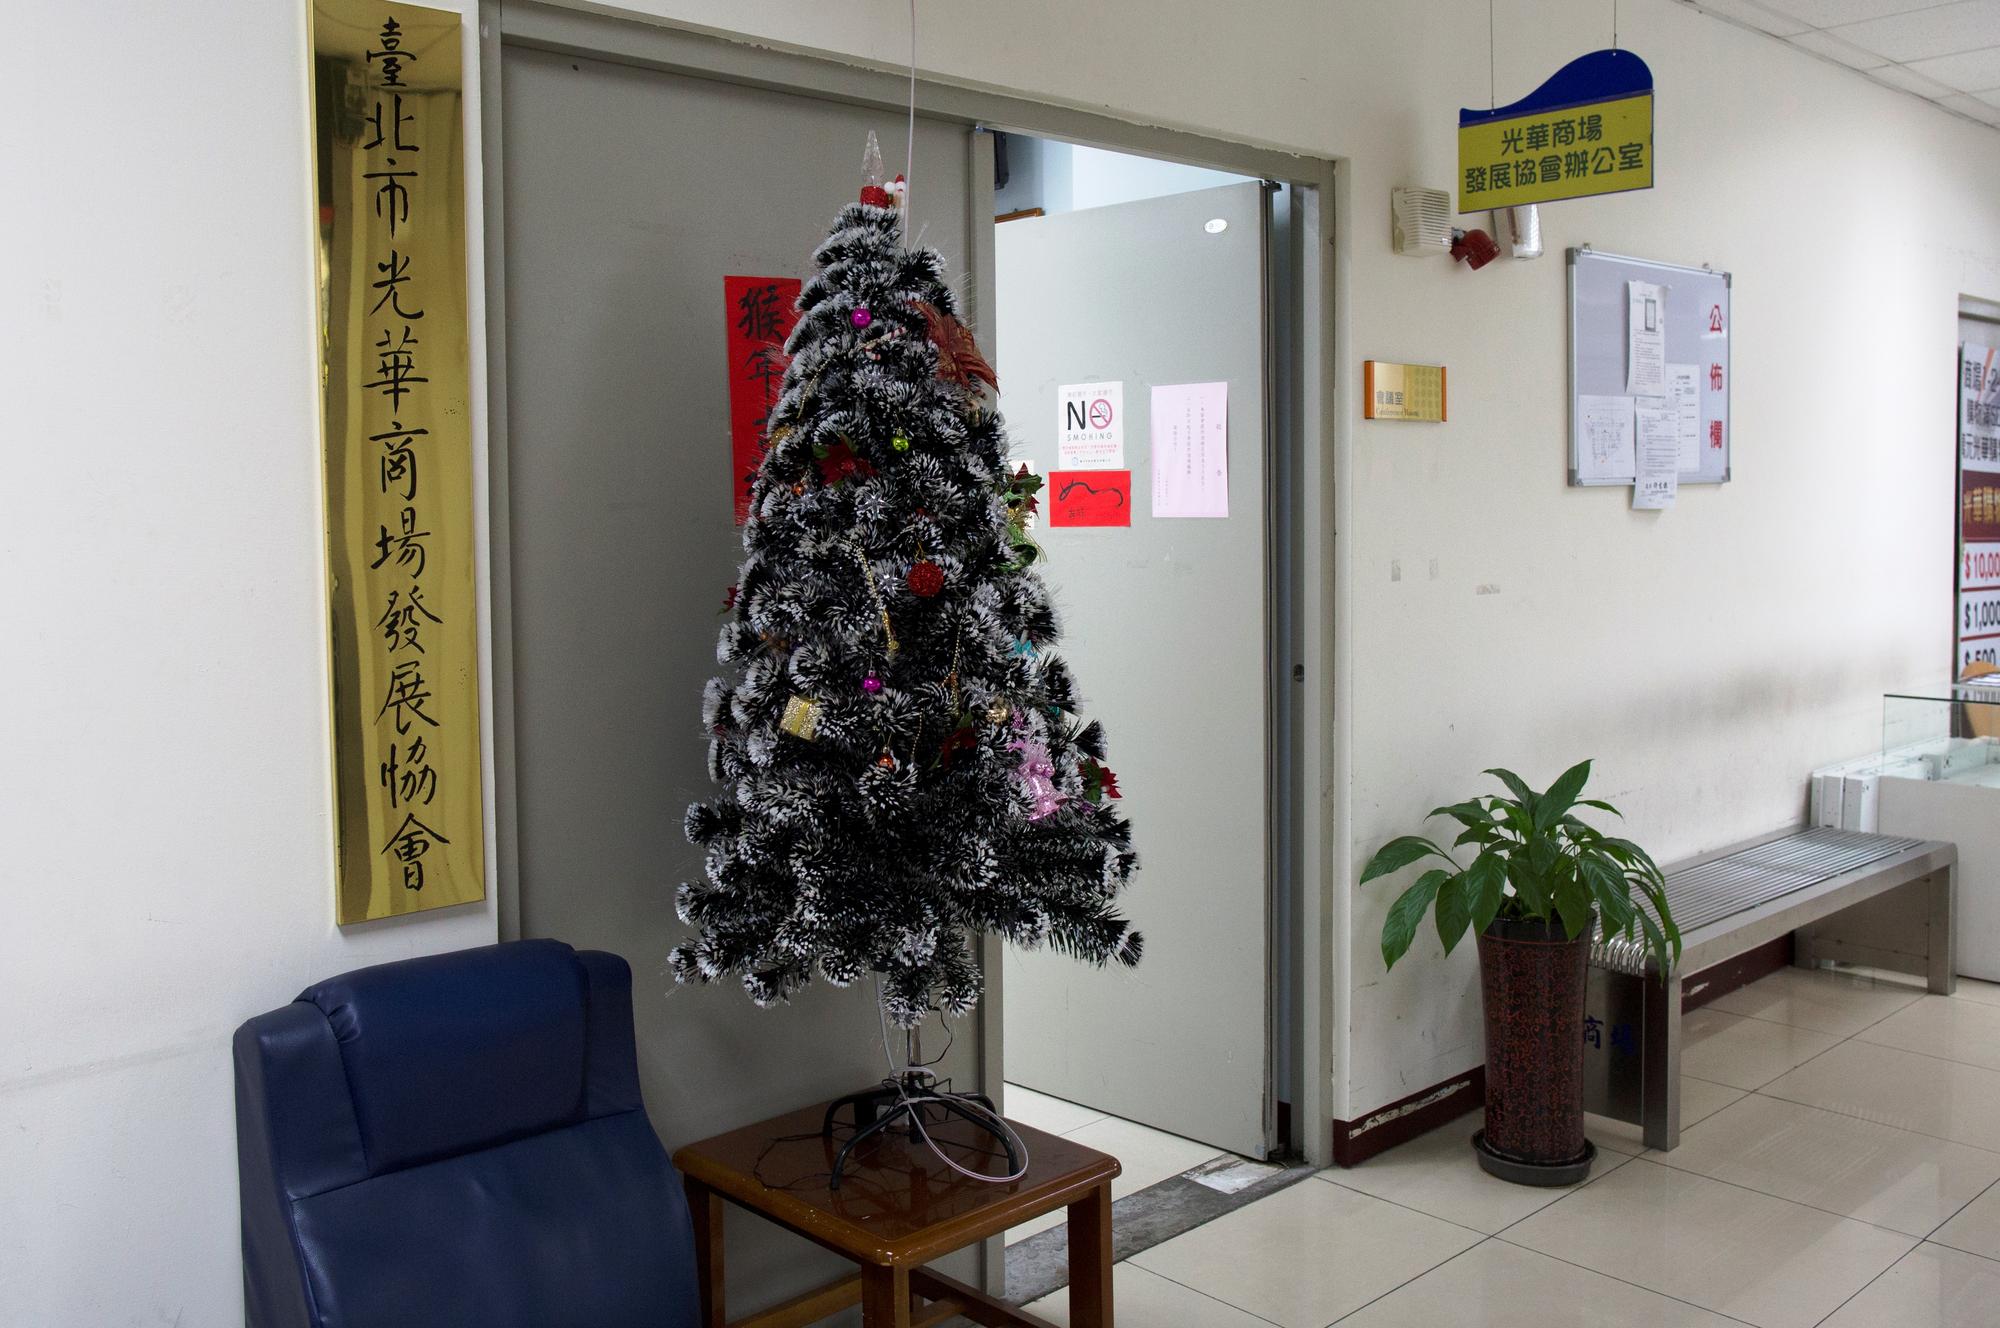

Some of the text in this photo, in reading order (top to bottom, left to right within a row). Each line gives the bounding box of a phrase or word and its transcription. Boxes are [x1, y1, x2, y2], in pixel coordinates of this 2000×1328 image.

[1501, 114, 1603, 156] 光華商場
[1465, 142, 1645, 194] 發展協會辦公室
[362, 16, 450, 892] 臺北市光華商場發展協會
[1067, 432, 1113, 442] SMOKING
